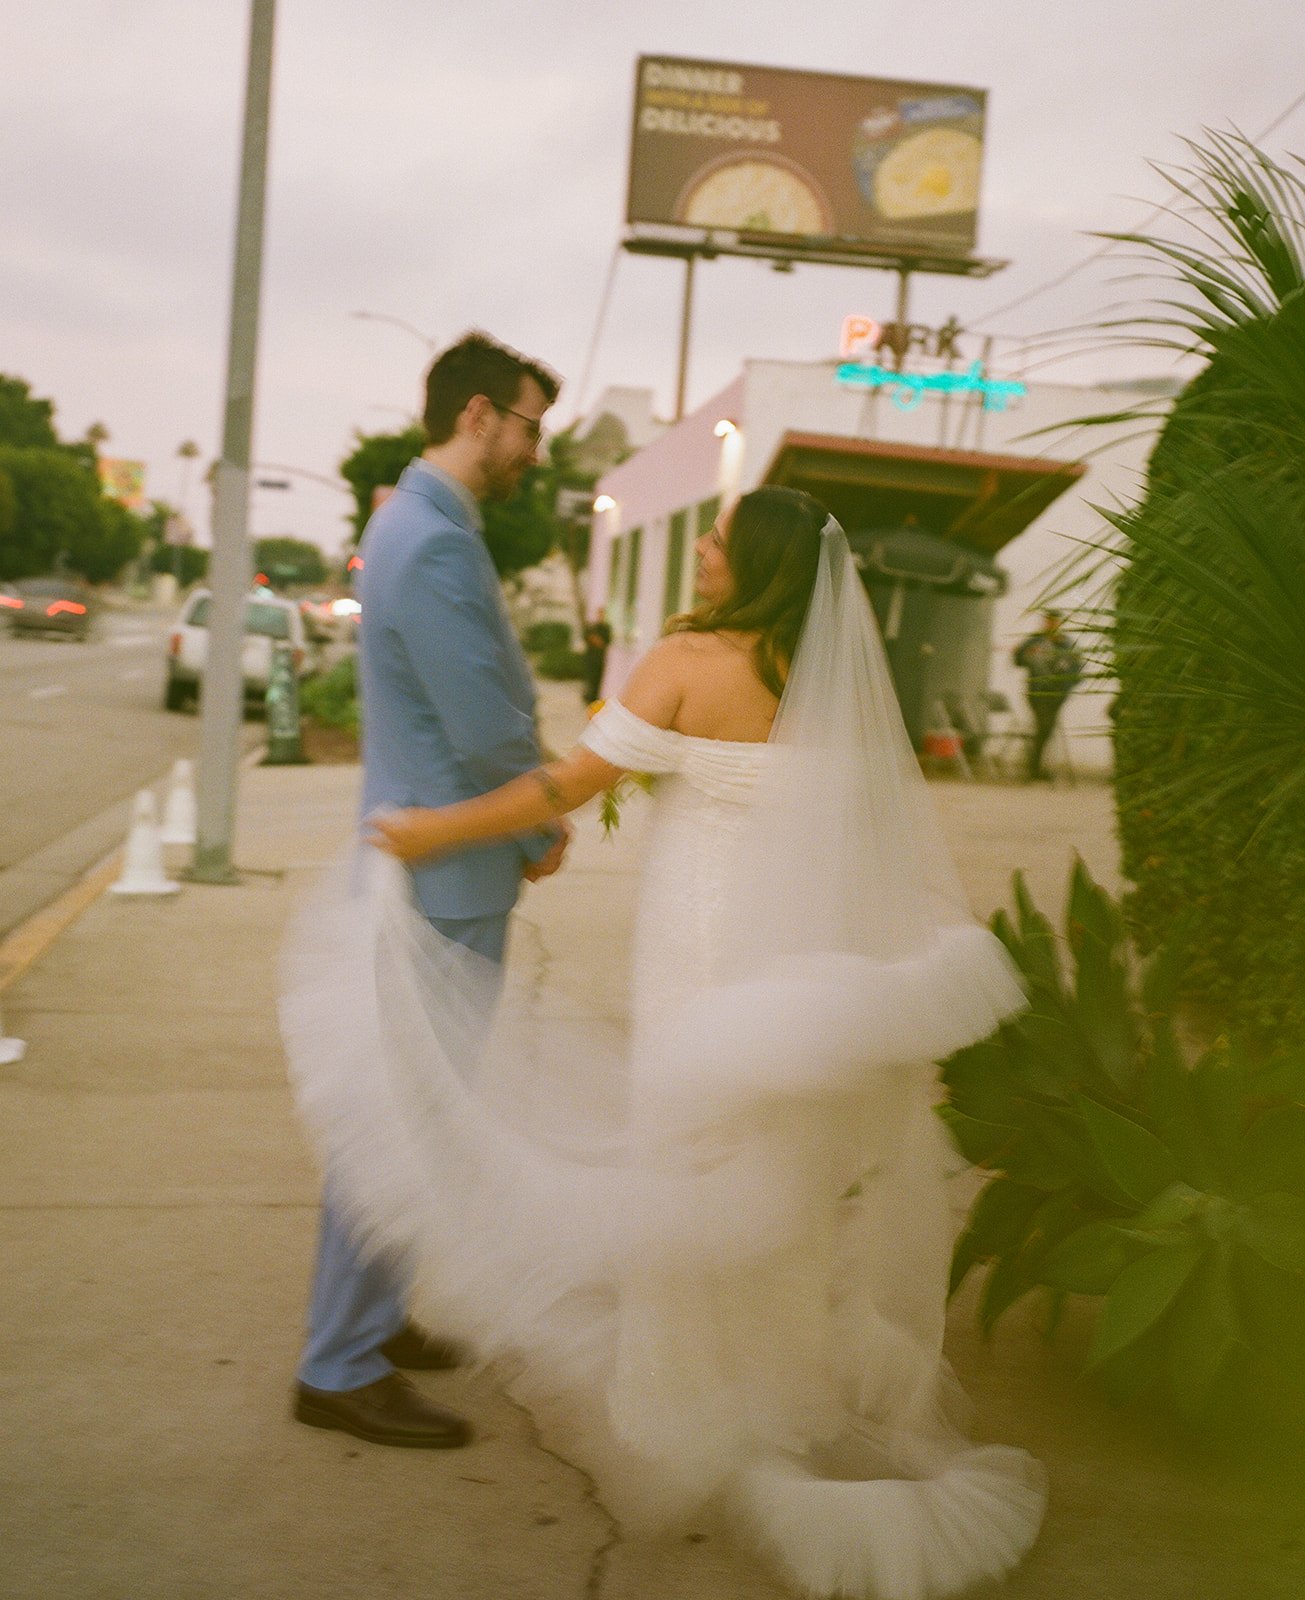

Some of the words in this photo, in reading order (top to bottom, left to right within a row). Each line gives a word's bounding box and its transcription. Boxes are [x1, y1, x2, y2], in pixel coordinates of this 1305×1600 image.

[643, 63, 744, 94] DINNER
[640, 107, 782, 143] DELICIOUS
[840, 313, 963, 359] PARK
